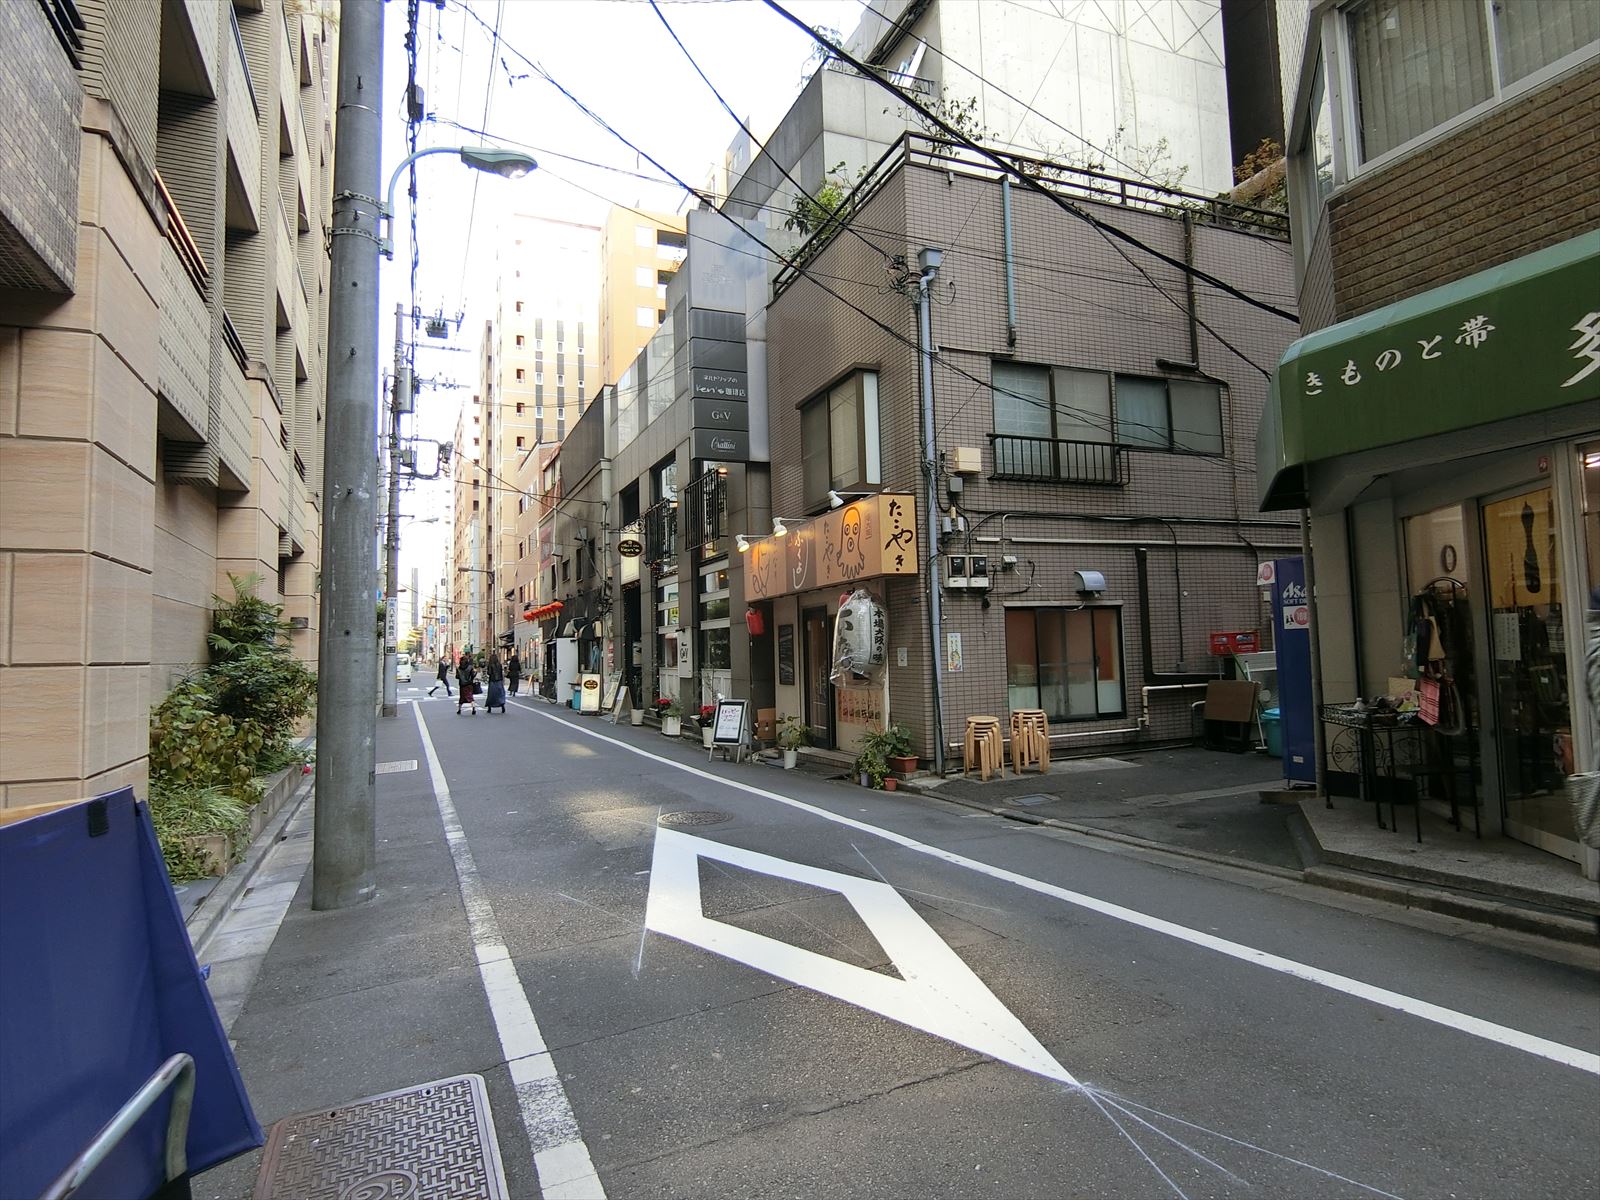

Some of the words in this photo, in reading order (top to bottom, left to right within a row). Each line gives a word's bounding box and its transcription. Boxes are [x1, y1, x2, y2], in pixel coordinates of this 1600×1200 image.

[1305, 315, 1496, 395] きものと帯
[711, 410, 731, 420] G&V
[884, 498, 913, 573] たこやき
[872, 608, 885, 664] 本場大阪の味
